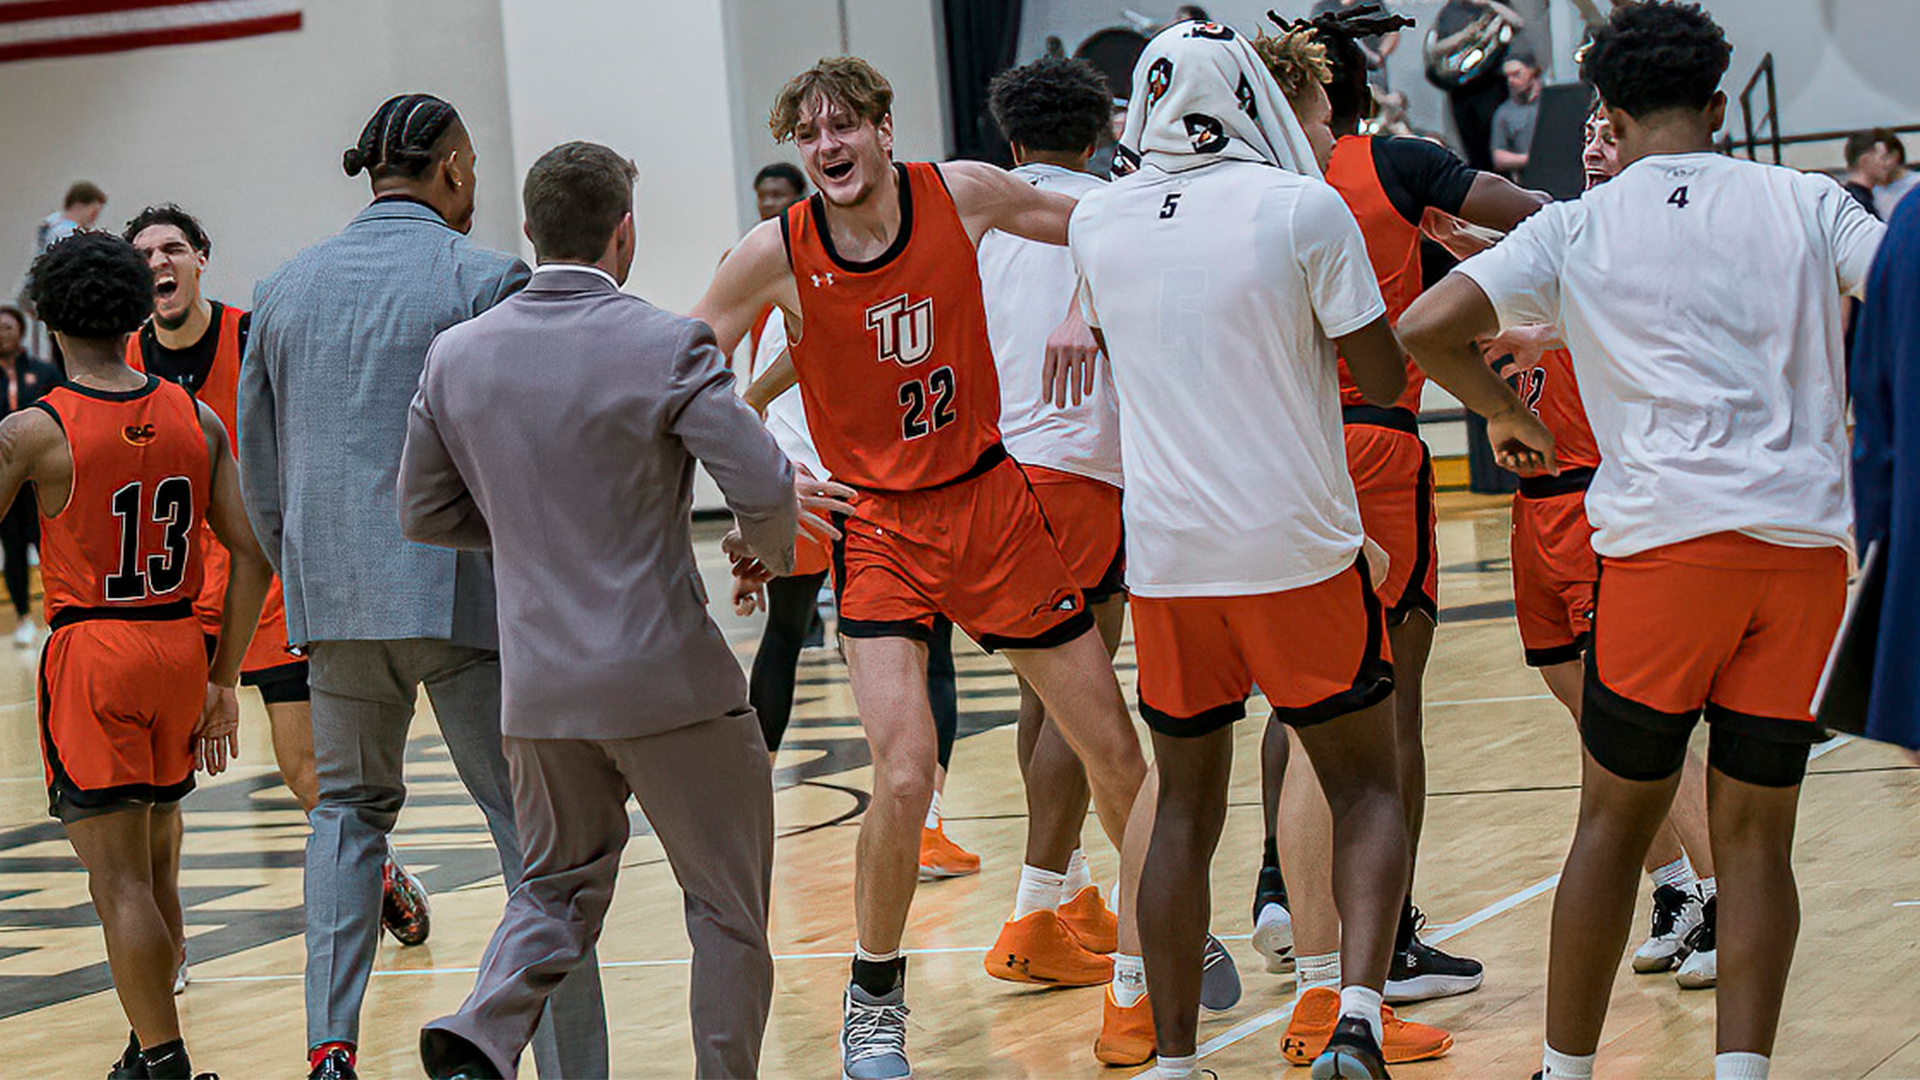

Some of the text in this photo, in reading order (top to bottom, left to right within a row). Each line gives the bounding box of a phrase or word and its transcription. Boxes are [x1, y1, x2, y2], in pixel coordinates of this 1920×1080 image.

[1159, 193, 1182, 219] 5
[1667, 185, 1689, 209] 4
[866, 293, 935, 367] TU
[898, 365, 957, 441] 22
[105, 476, 194, 601] 13
